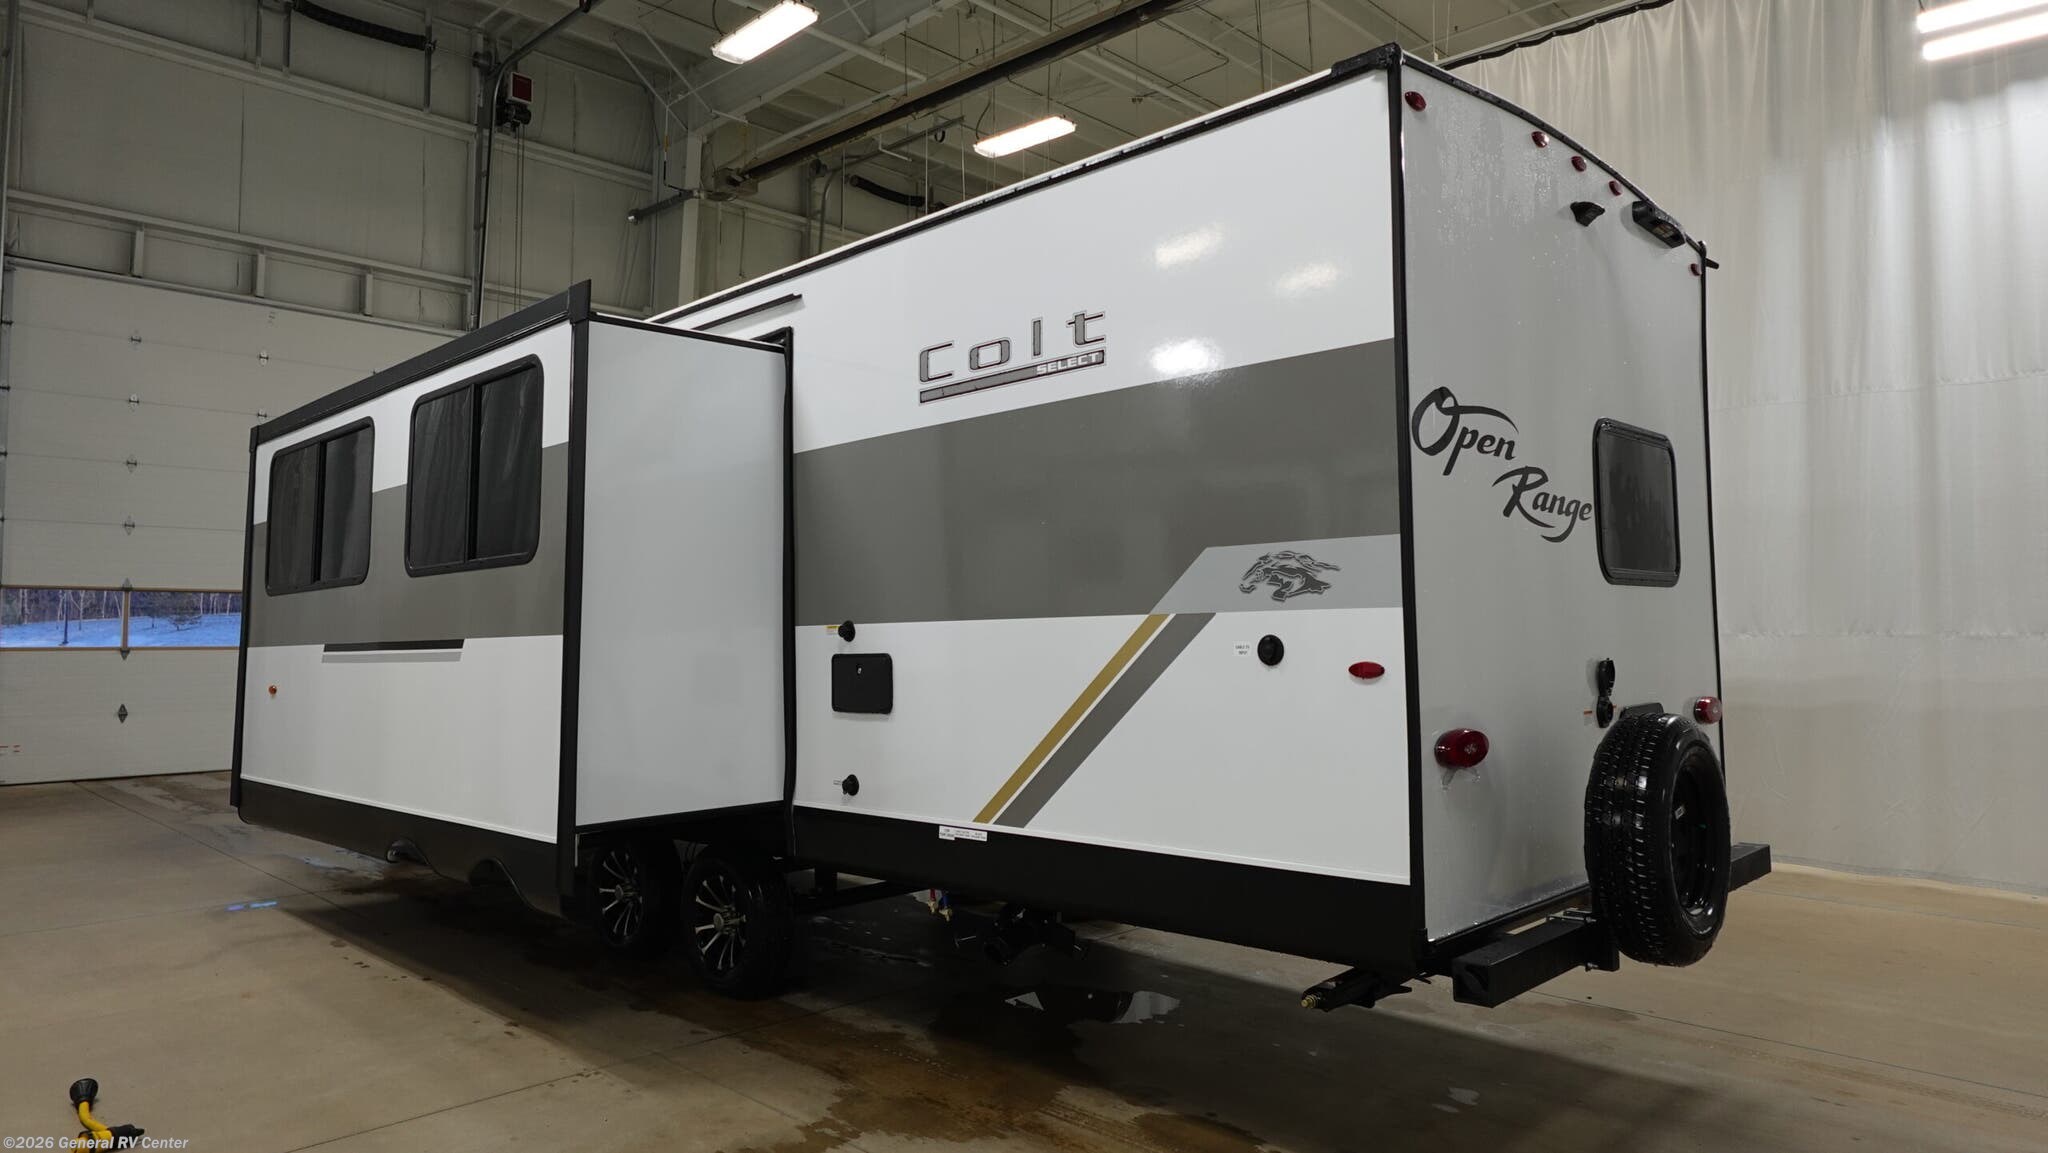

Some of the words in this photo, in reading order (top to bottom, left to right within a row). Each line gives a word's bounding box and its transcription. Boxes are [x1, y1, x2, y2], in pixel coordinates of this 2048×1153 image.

[919, 312, 1105, 383] Colt
[1036, 352, 1099, 376] SELECT
[1411, 386, 1520, 476] Open
[1491, 465, 1593, 543] Range
